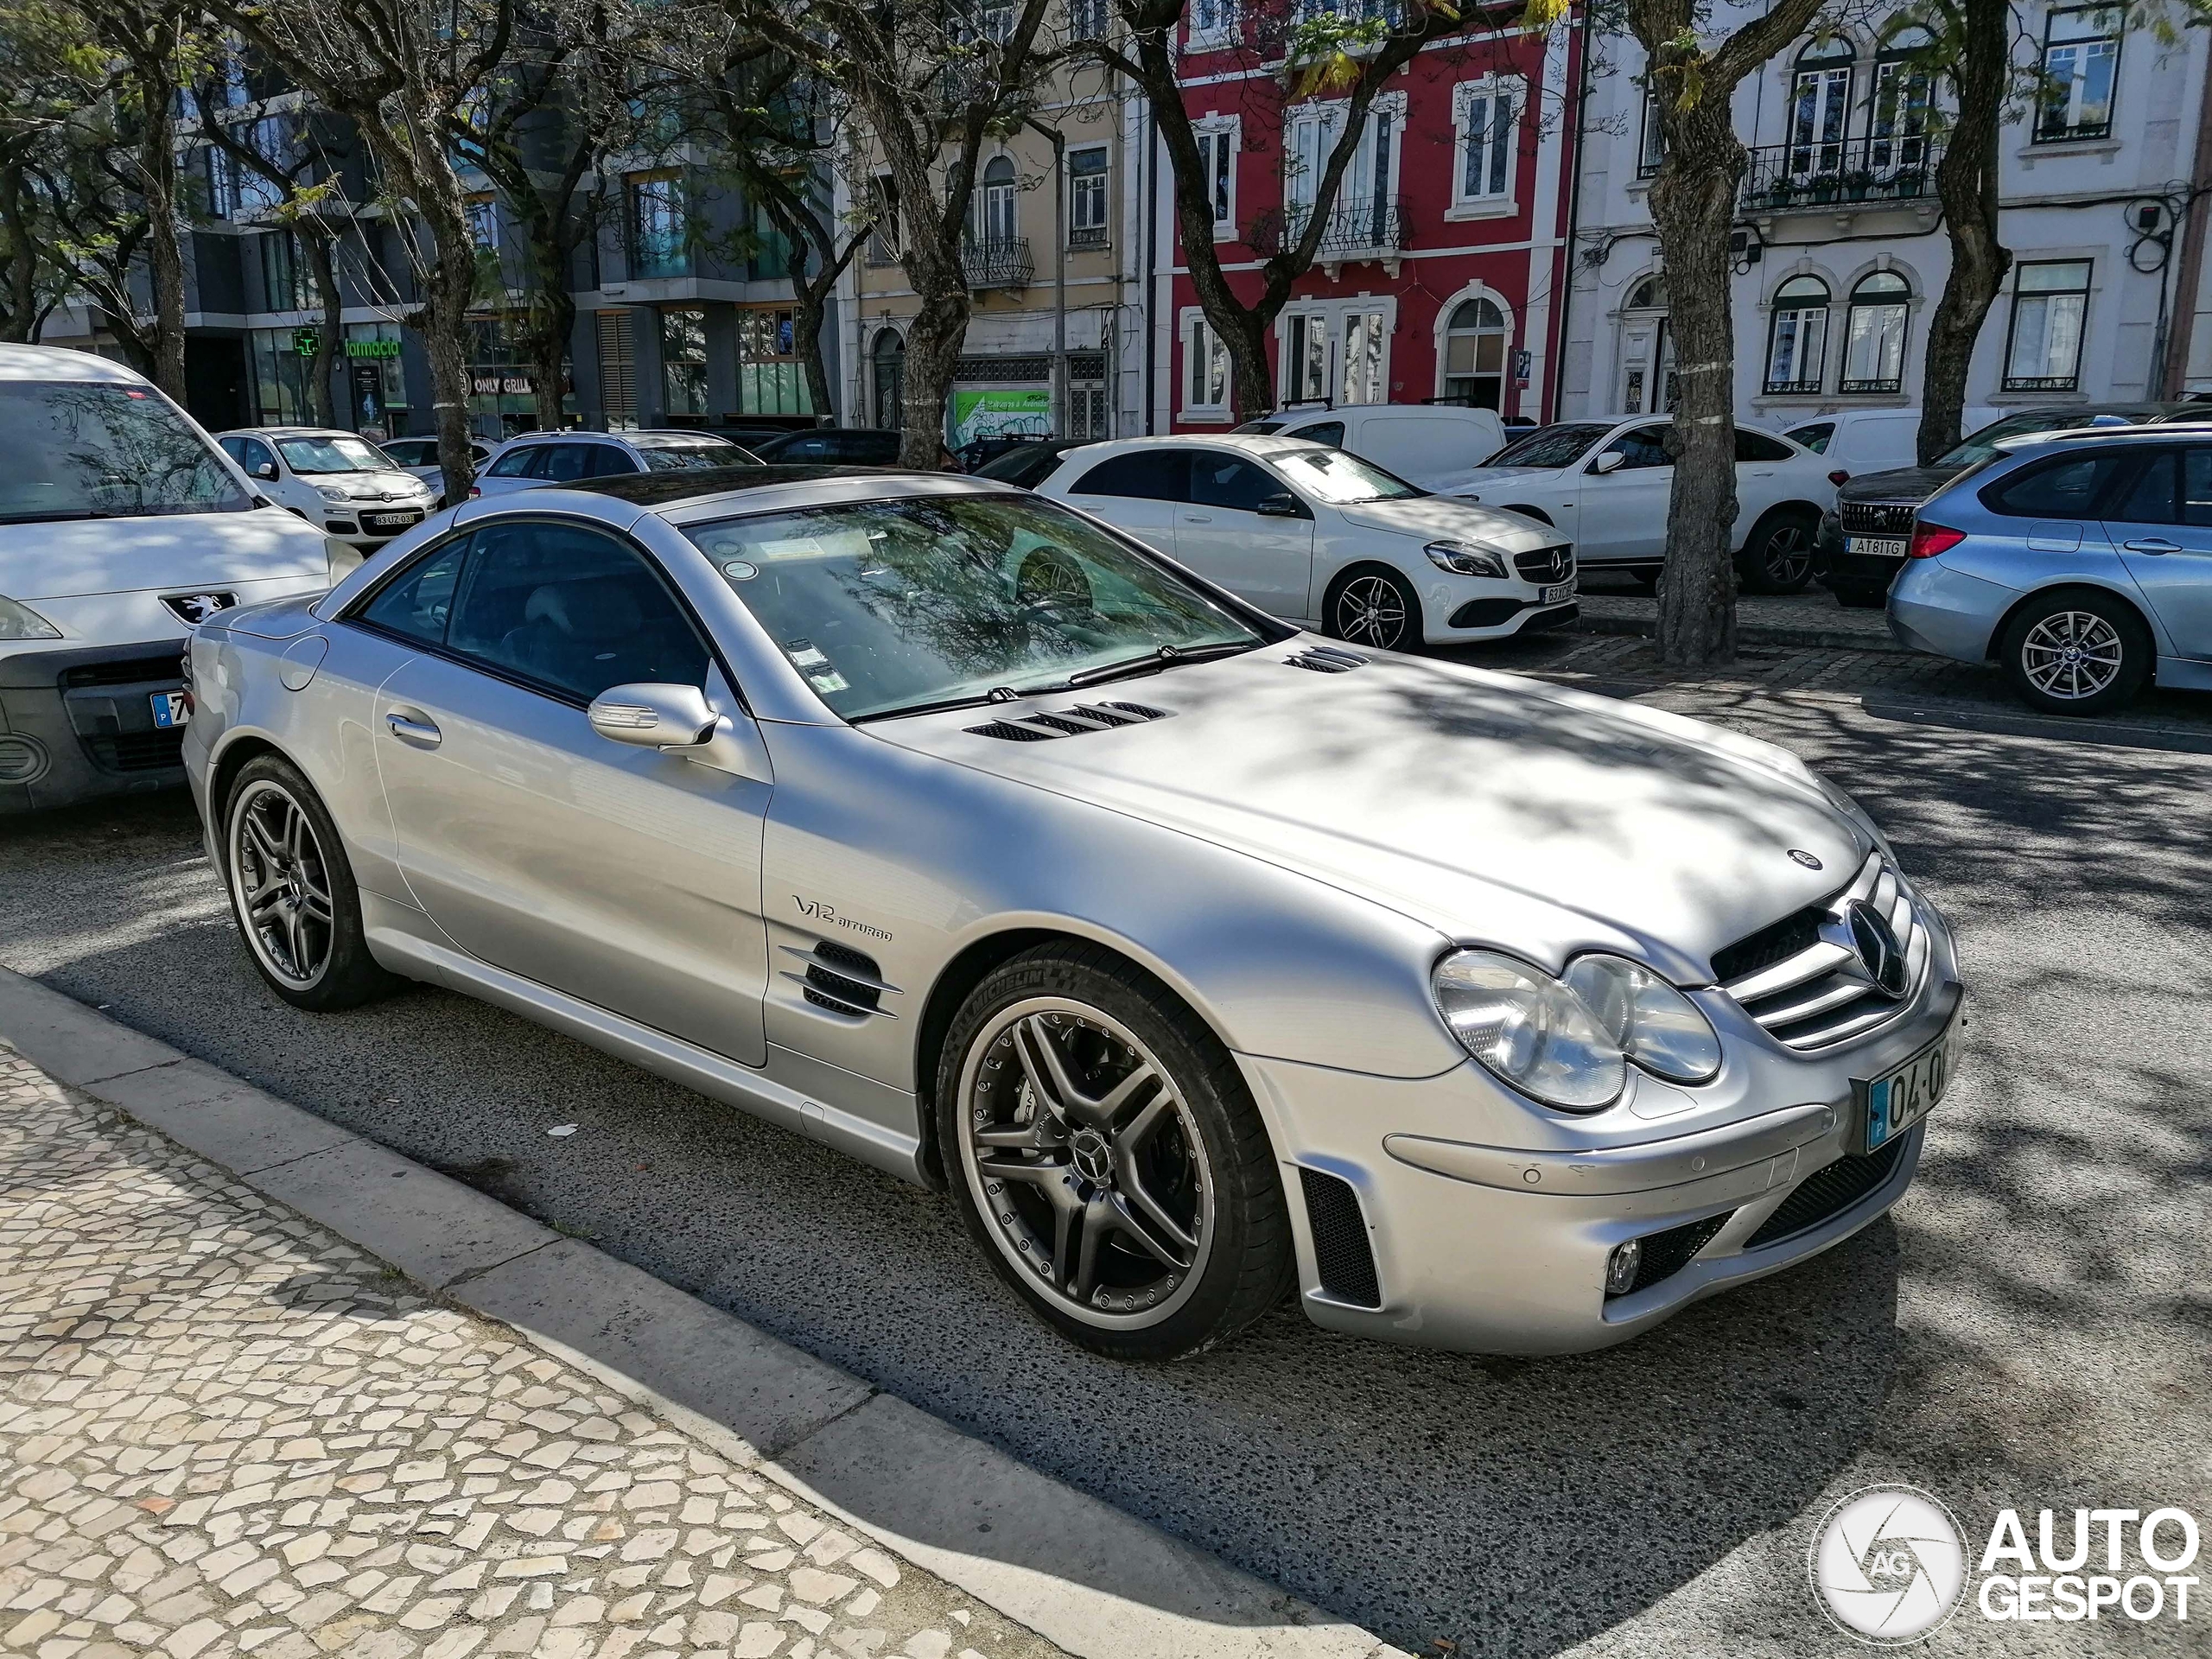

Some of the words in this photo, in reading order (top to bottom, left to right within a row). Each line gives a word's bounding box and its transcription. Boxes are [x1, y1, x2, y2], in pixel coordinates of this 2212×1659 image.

[1518, 354, 1524, 372] P
[474, 377, 499, 393] ONLY
[503, 378, 531, 394] GRILL
[791, 894, 835, 924] V12
[836, 917, 893, 942] BITURBO
[970, 968, 1046, 1016] MICHELIN
[1876, 1122, 1883, 1138] P
